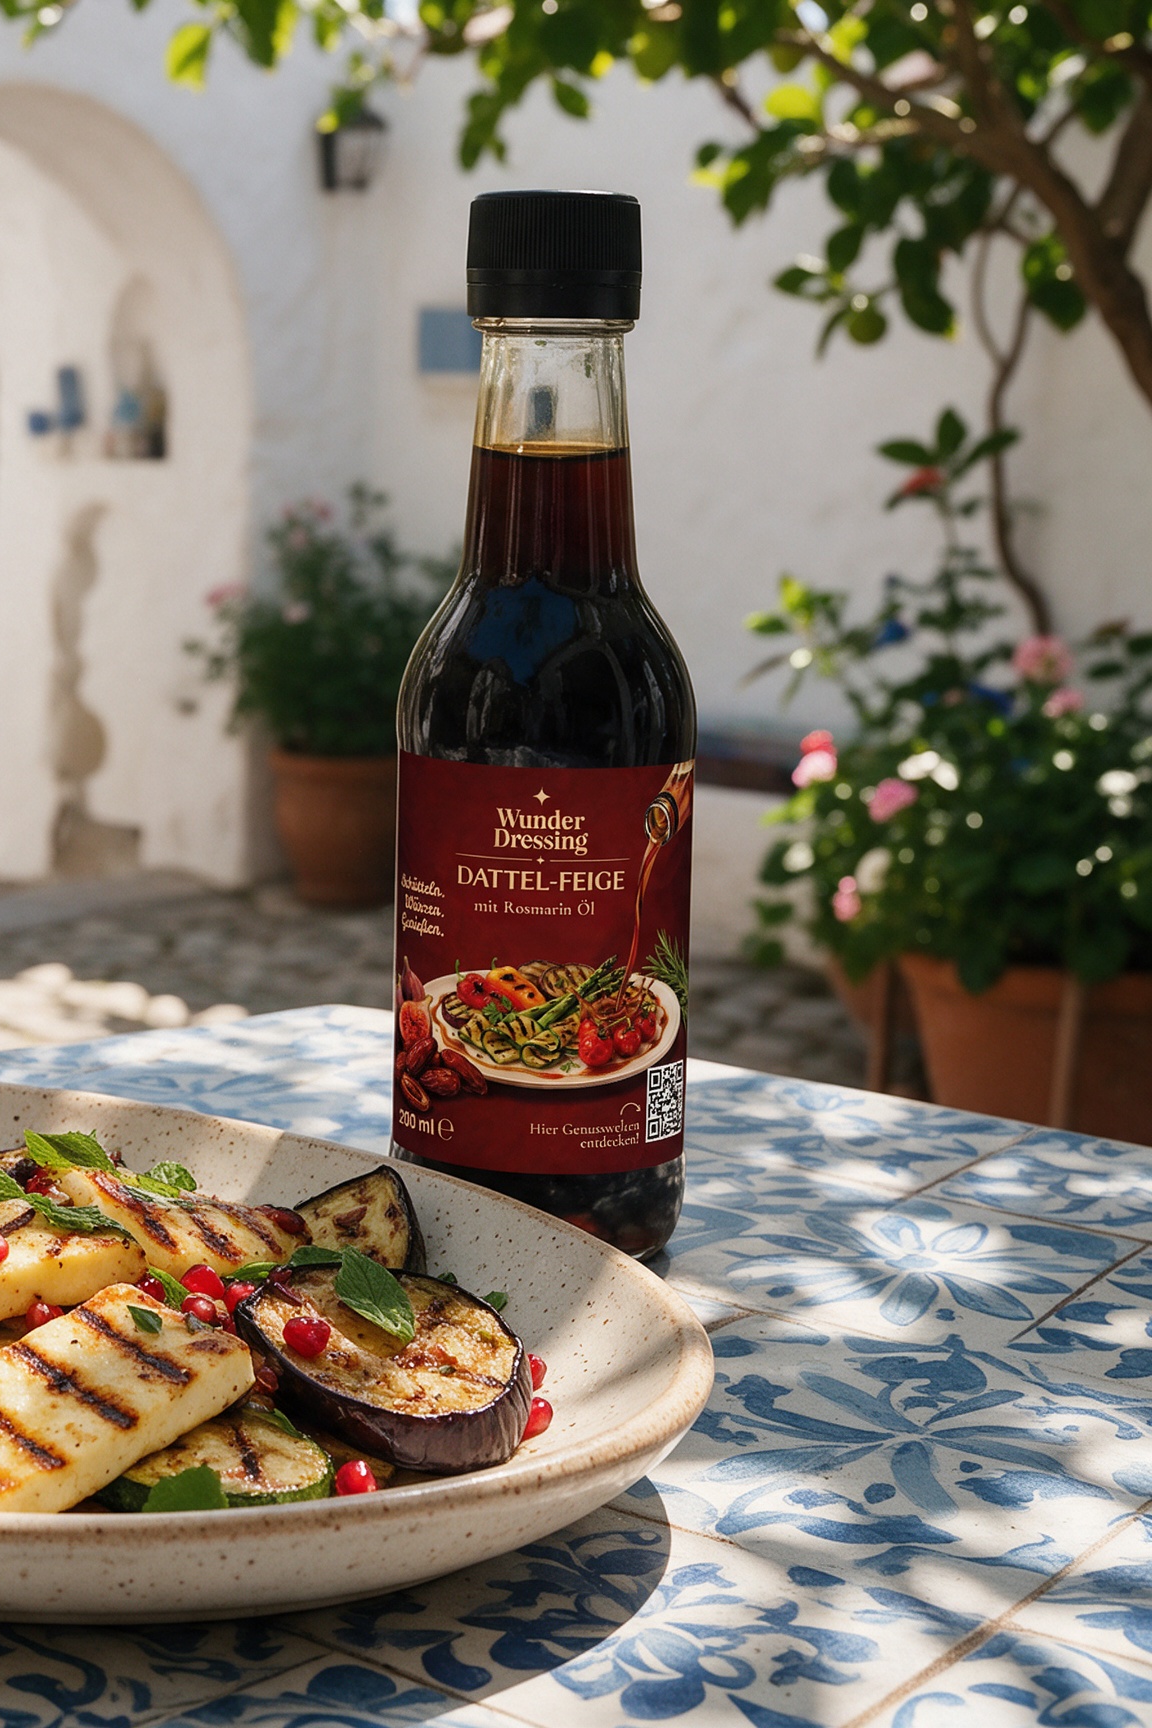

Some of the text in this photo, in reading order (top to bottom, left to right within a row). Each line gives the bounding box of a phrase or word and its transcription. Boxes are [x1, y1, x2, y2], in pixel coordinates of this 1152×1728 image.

[496, 807, 586, 830] Wunder
[493, 828, 589, 856] Dressing
[457, 864, 625, 892] DATTEL-FEIGE
[474, 900, 595, 916] mit Rosmarin Öl
[398, 1109, 416, 1128] 200
[418, 1115, 434, 1136] ml
[530, 1123, 558, 1135] Hier
[580, 1132, 640, 1149] entdecken!
